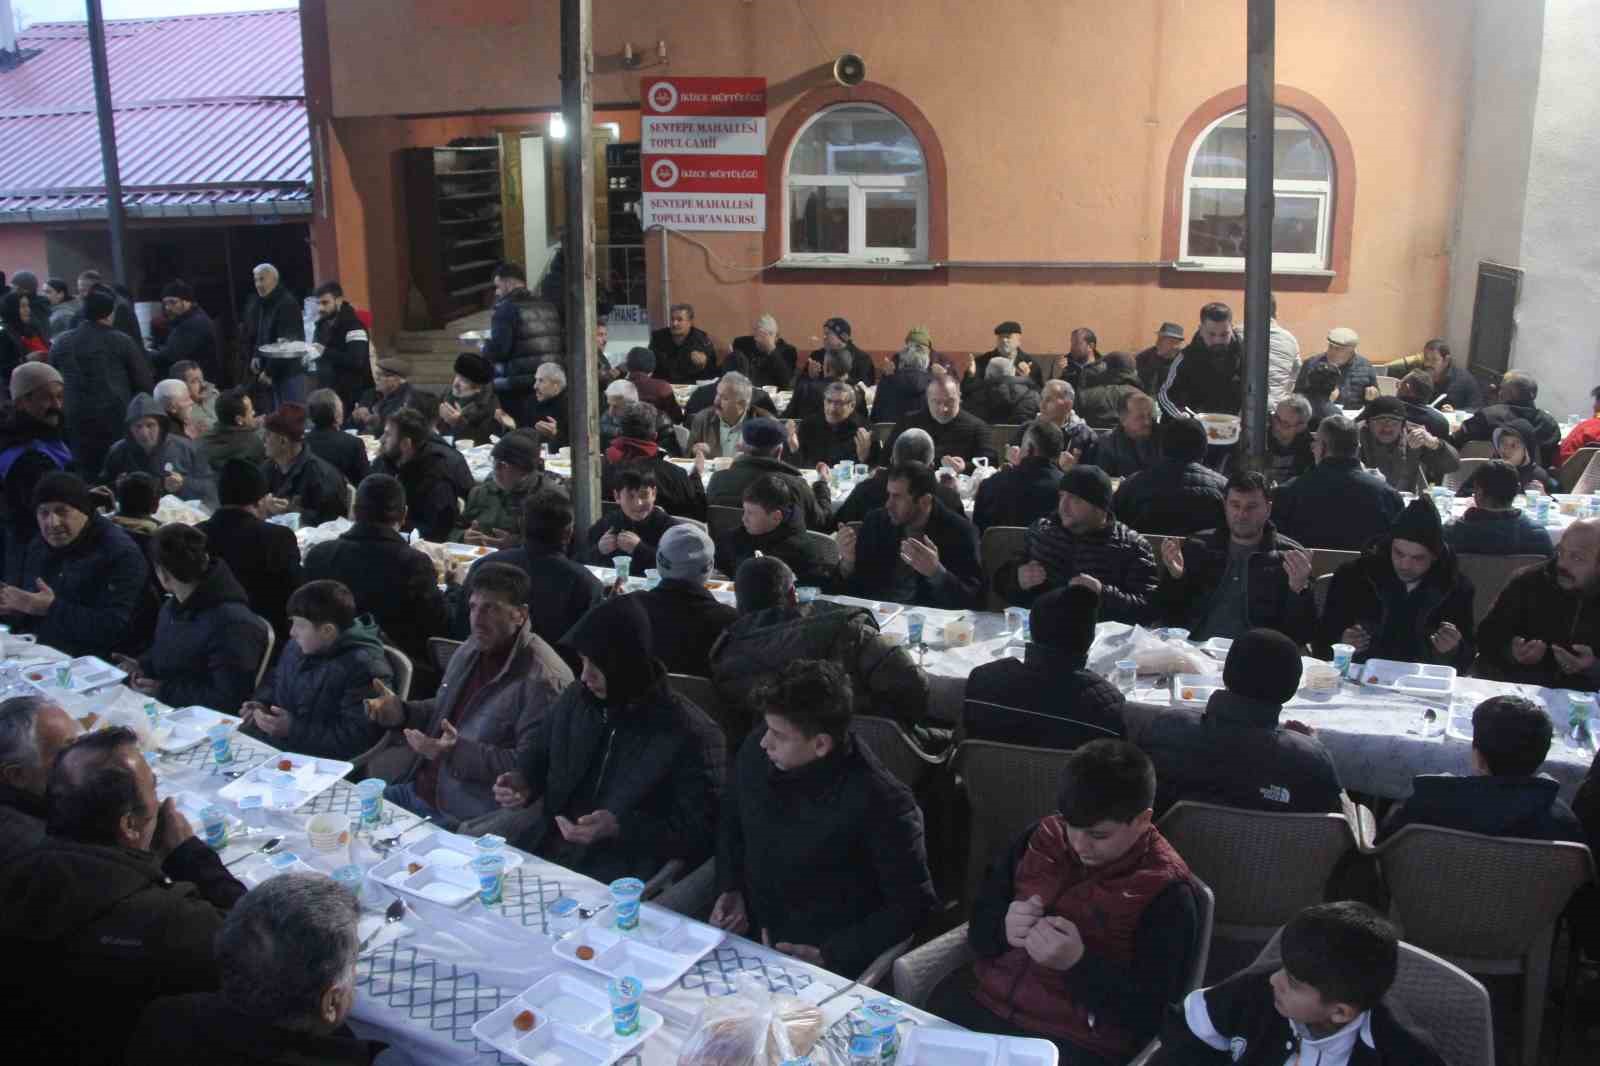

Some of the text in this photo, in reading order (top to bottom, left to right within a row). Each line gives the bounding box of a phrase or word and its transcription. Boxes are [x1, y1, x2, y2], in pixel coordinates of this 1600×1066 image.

[651, 138, 681, 149] TOPUL
[695, 198, 754, 209] MAHALLESİ
[651, 214, 683, 224] TOPUL
[723, 214, 758, 224] KURSU
